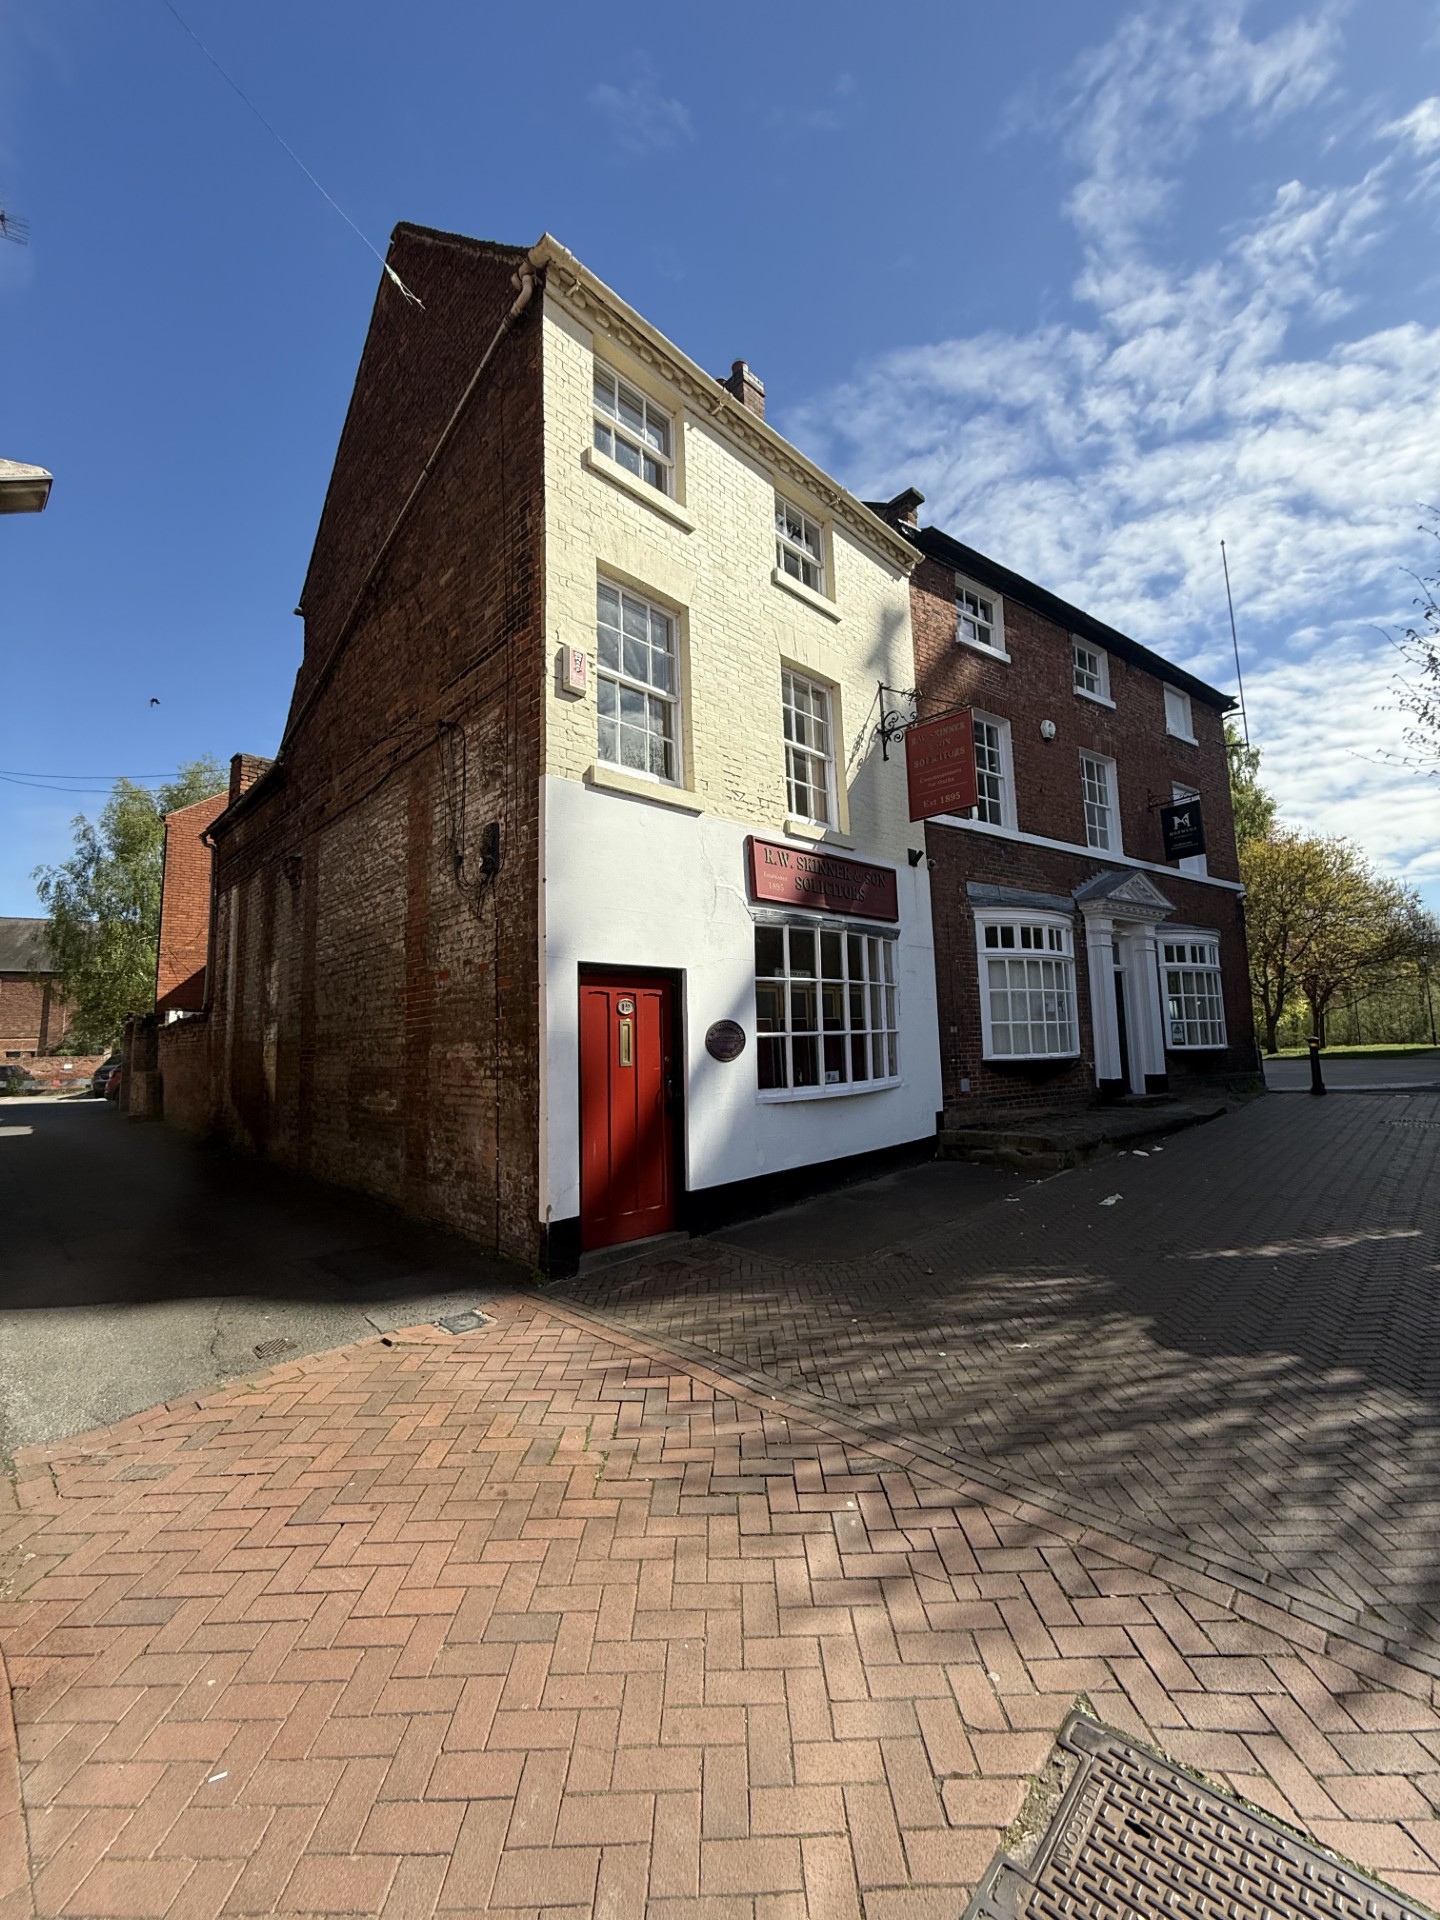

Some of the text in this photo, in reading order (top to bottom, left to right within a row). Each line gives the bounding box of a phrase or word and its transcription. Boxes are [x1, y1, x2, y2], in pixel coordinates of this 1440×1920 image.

[930, 721, 966, 737] SKINNER
[913, 746, 966, 769] SOLICITORS
[940, 791, 961, 804] 1895
[763, 871, 788, 881] Established
[797, 856, 852, 880] SKINNER
[854, 872, 861, 883] &
[864, 870, 886, 888] SON
[769, 882, 785, 893] 1895
[795, 876, 865, 902] SOLICITORS
[1054, 1779, 1102, 1869] TELECOM
